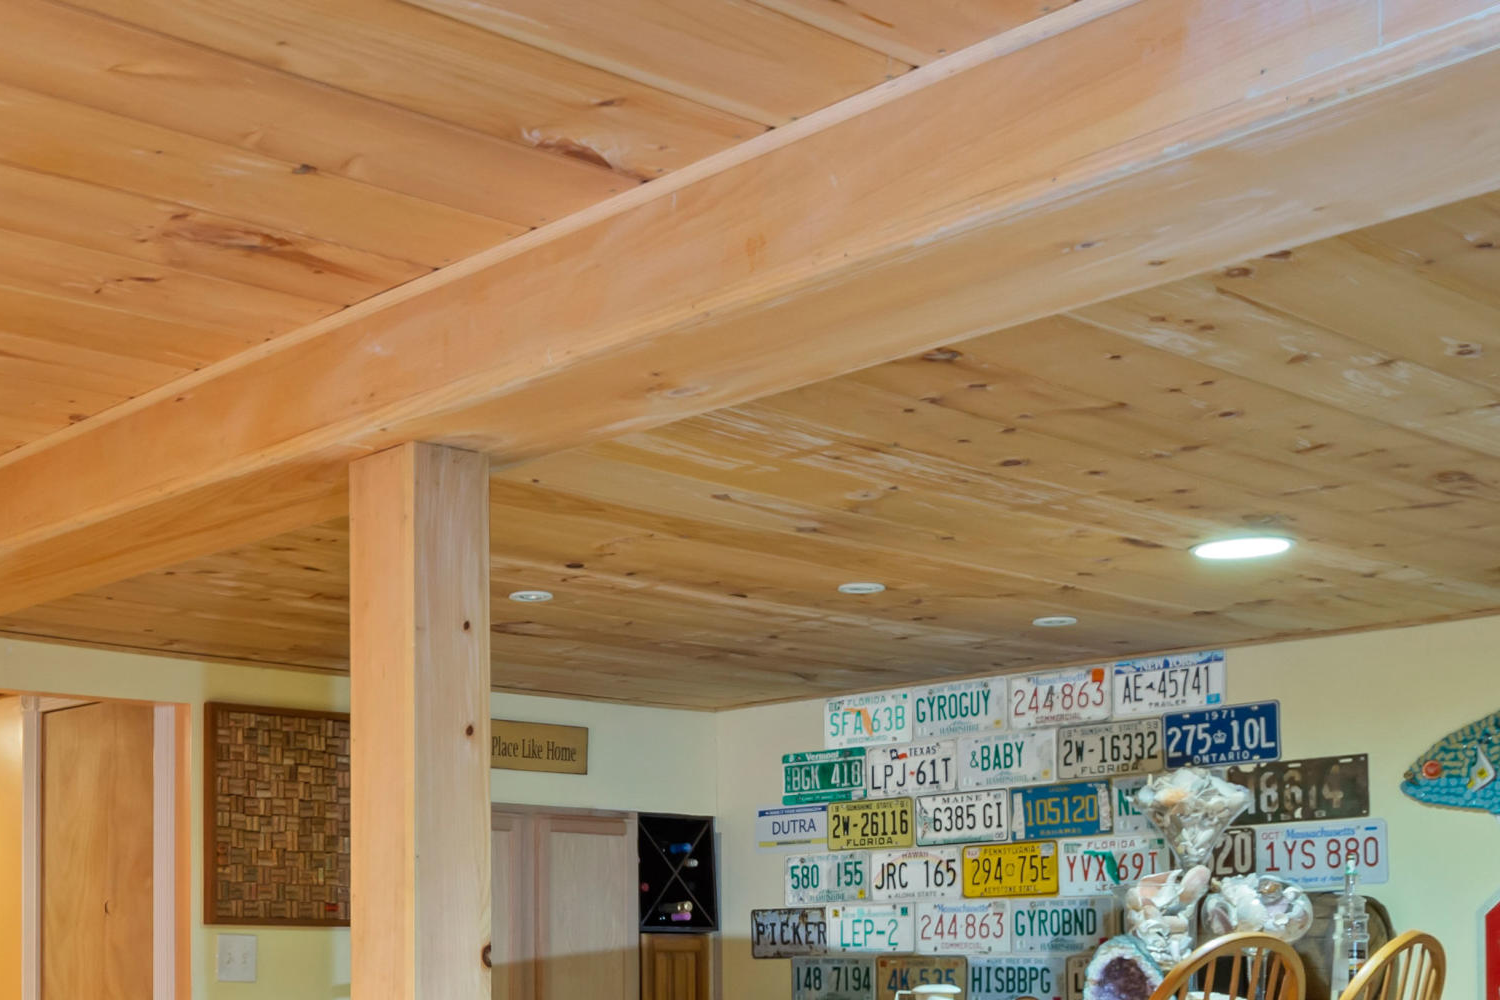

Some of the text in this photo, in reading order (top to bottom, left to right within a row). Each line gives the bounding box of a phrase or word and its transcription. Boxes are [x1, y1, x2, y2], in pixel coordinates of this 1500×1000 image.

[1123, 666, 1210, 705] AE 45741
[916, 689, 991, 724] GYROGUY
[1205, 709, 1236, 721] 1971
[491, 735, 577, 762] Place Like Home
[908, 746, 937, 757] TEXAS
[1063, 730, 1159, 767] 2W-16332
[1167, 717, 1276, 758] 275 10L
[1081, 762, 1139, 775] FLORIDA
[1193, 751, 1251, 766] ONTARIO
[871, 757, 952, 790] LPJ 61T
[941, 794, 982, 805] MAINE
[1026, 795, 1098, 827] 105120
[772, 818, 817, 836] DUTRA
[832, 809, 909, 839] 2W-26116
[933, 803, 977, 833] 6385
[846, 836, 894, 847] FLORIDA
[1086, 840, 1136, 850] FLORIDA
[1265, 836, 1379, 872] 1YS 880
[790, 864, 820, 889] 580
[875, 859, 957, 890] JRC 165
[972, 855, 1051, 885] 294 75E
[756, 921, 827, 946] PICKER
[841, 919, 899, 947] LEP-2
[1015, 908, 1097, 937] GYROBND
[971, 966, 1051, 994] HISBBPG
